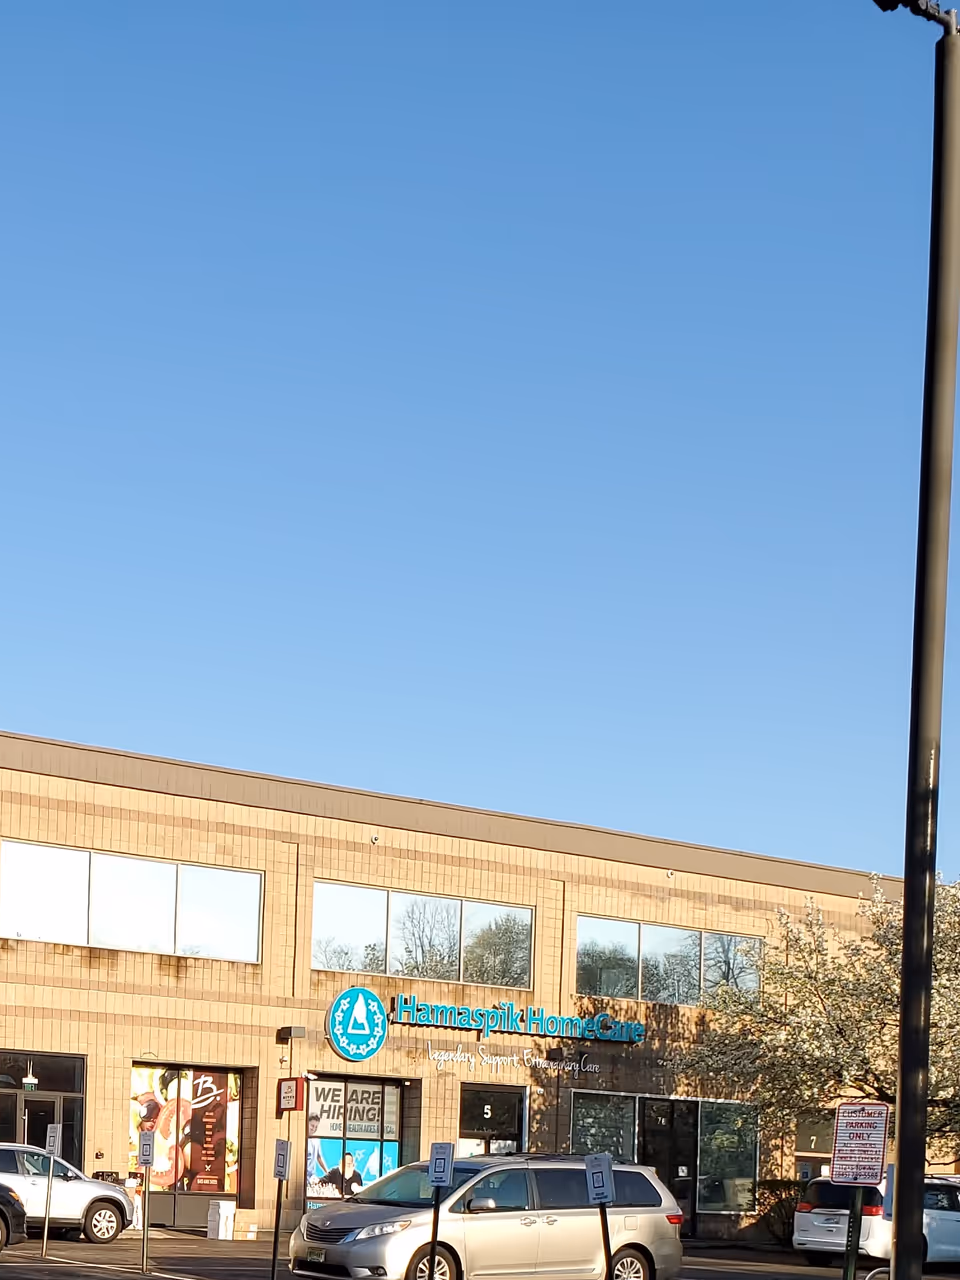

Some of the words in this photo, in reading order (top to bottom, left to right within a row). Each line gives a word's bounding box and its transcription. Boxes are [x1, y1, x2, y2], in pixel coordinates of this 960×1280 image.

[396, 992, 523, 1038] Hamaspik
[527, 1006, 646, 1042] HomeCare
[427, 1040, 476, 1071] Legendary
[478, 1045, 521, 1073] Support,
[581, 1053, 601, 1074] Care
[314, 1086, 342, 1103] WE
[348, 1089, 382, 1106] ARE
[319, 1104, 381, 1123] HIRING!
[483, 1104, 492, 1119] 5
[842, 1111, 883, 1119] CUSTOMER
[347, 1123, 363, 1133] EALTH
[845, 1120, 878, 1130] PARKING
[810, 1135, 817, 1149] 7
[848, 1131, 872, 1141] ONLY
